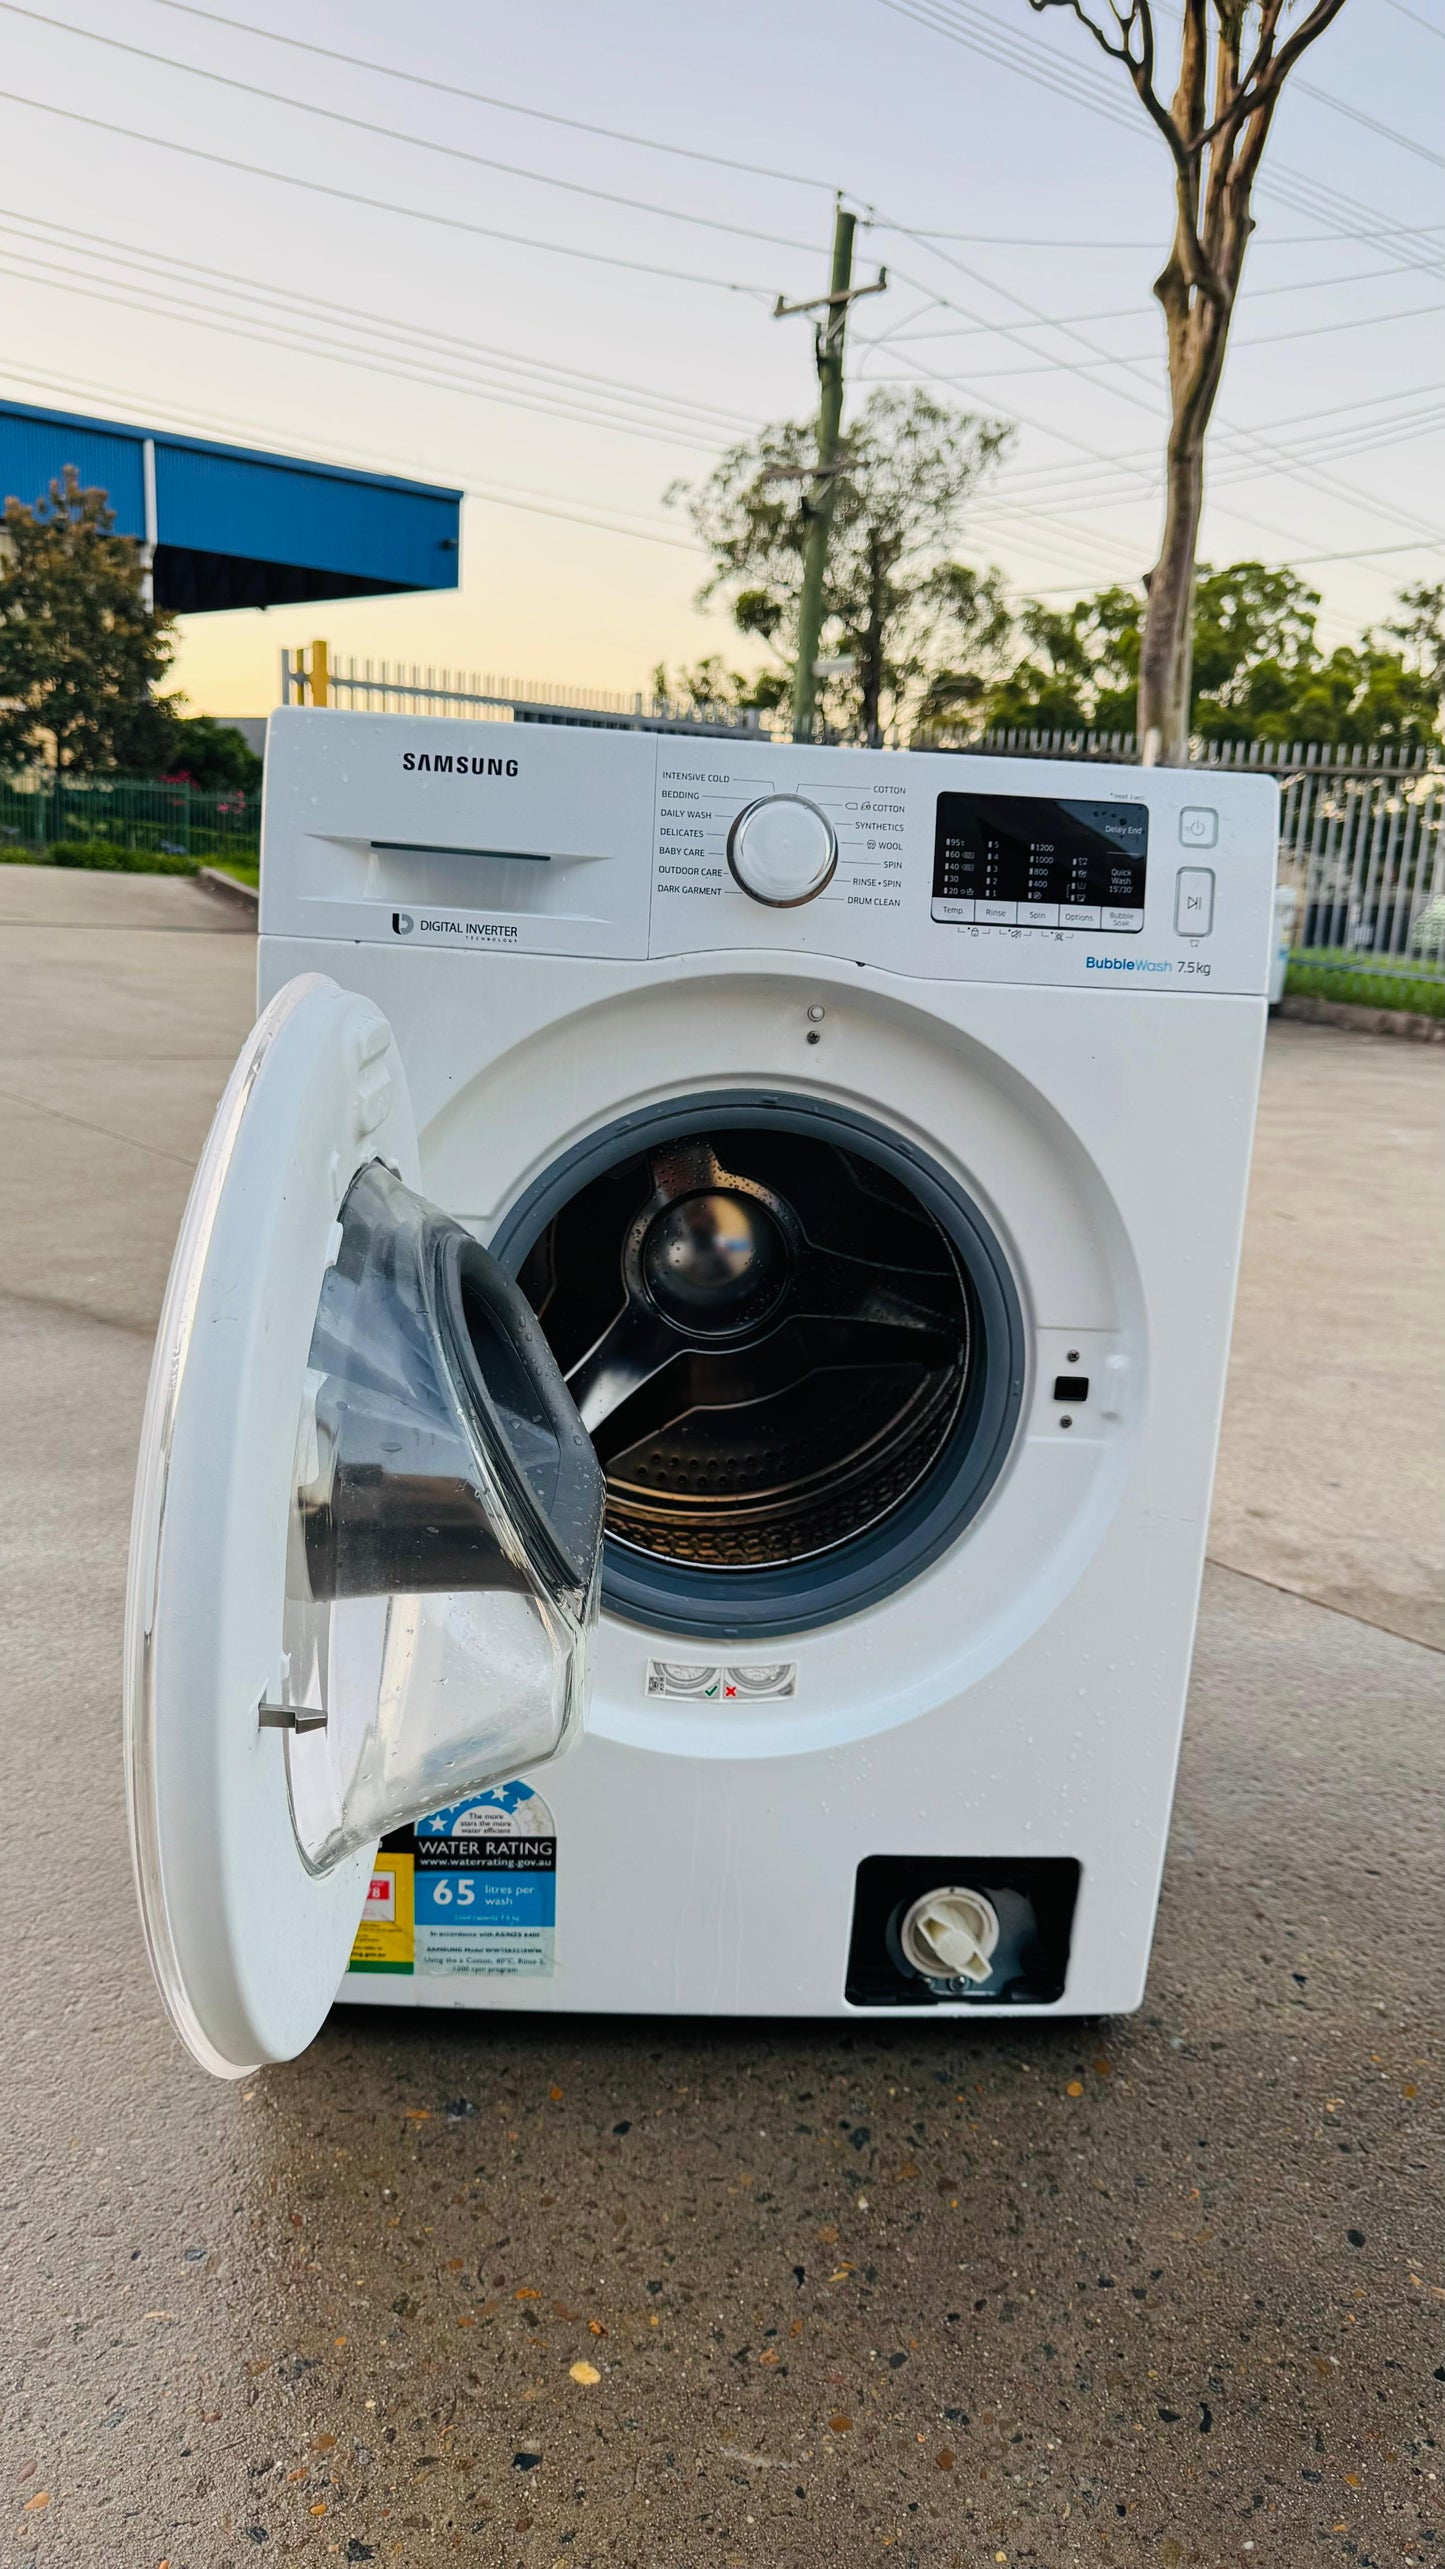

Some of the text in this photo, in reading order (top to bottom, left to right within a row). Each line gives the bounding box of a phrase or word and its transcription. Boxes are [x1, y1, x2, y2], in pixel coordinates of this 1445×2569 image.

[403, 753, 518, 777] SAMSUNG
[662, 771, 730, 783] INTENSIVE COLD
[873, 785, 906, 795] COTTON
[661, 790, 700, 800] BEDDING
[872, 803, 905, 813] COTTON
[660, 809, 712, 820] DAILY WASH
[855, 822, 905, 832] SYNTHETICS
[1105, 825, 1126, 835] Delay
[660, 828, 704, 838] DELICATES
[878, 842, 903, 851] WOOL
[1035, 844, 1054, 852] 1200
[659, 846, 705, 857] BABY CARE
[949, 851, 960, 859] 60
[1035, 856, 1054, 864] 1000
[883, 861, 902, 869] SPIN
[949, 863, 960, 871] 40
[658, 865, 722, 877] OUTDOOR CARE
[1034, 868, 1049, 876] 800
[1111, 868, 1132, 877] Quick
[949, 875, 959, 883] 30
[1111, 877, 1131, 885] Wash
[1033, 880, 1048, 888] 400
[657, 884, 722, 895] DARK GARMENT
[948, 887, 959, 895] 20
[847, 896, 901, 907] DRUM CLEAN
[985, 908, 1006, 917] Rinse
[1029, 911, 1046, 920] Spin
[1109, 911, 1134, 919] Bubble
[1065, 913, 1094, 922] Options
[420, 920, 518, 937] DIGITAL INVERTER
[469, 1812, 483, 1820] The
[419, 1841, 552, 1855] WATER RATING
[420, 1857, 552, 1869] www.waterrating.gov.au
[433, 1879, 475, 1905] 65
[485, 1884, 535, 1897] litres per
[484, 1897, 513, 1906] wash
